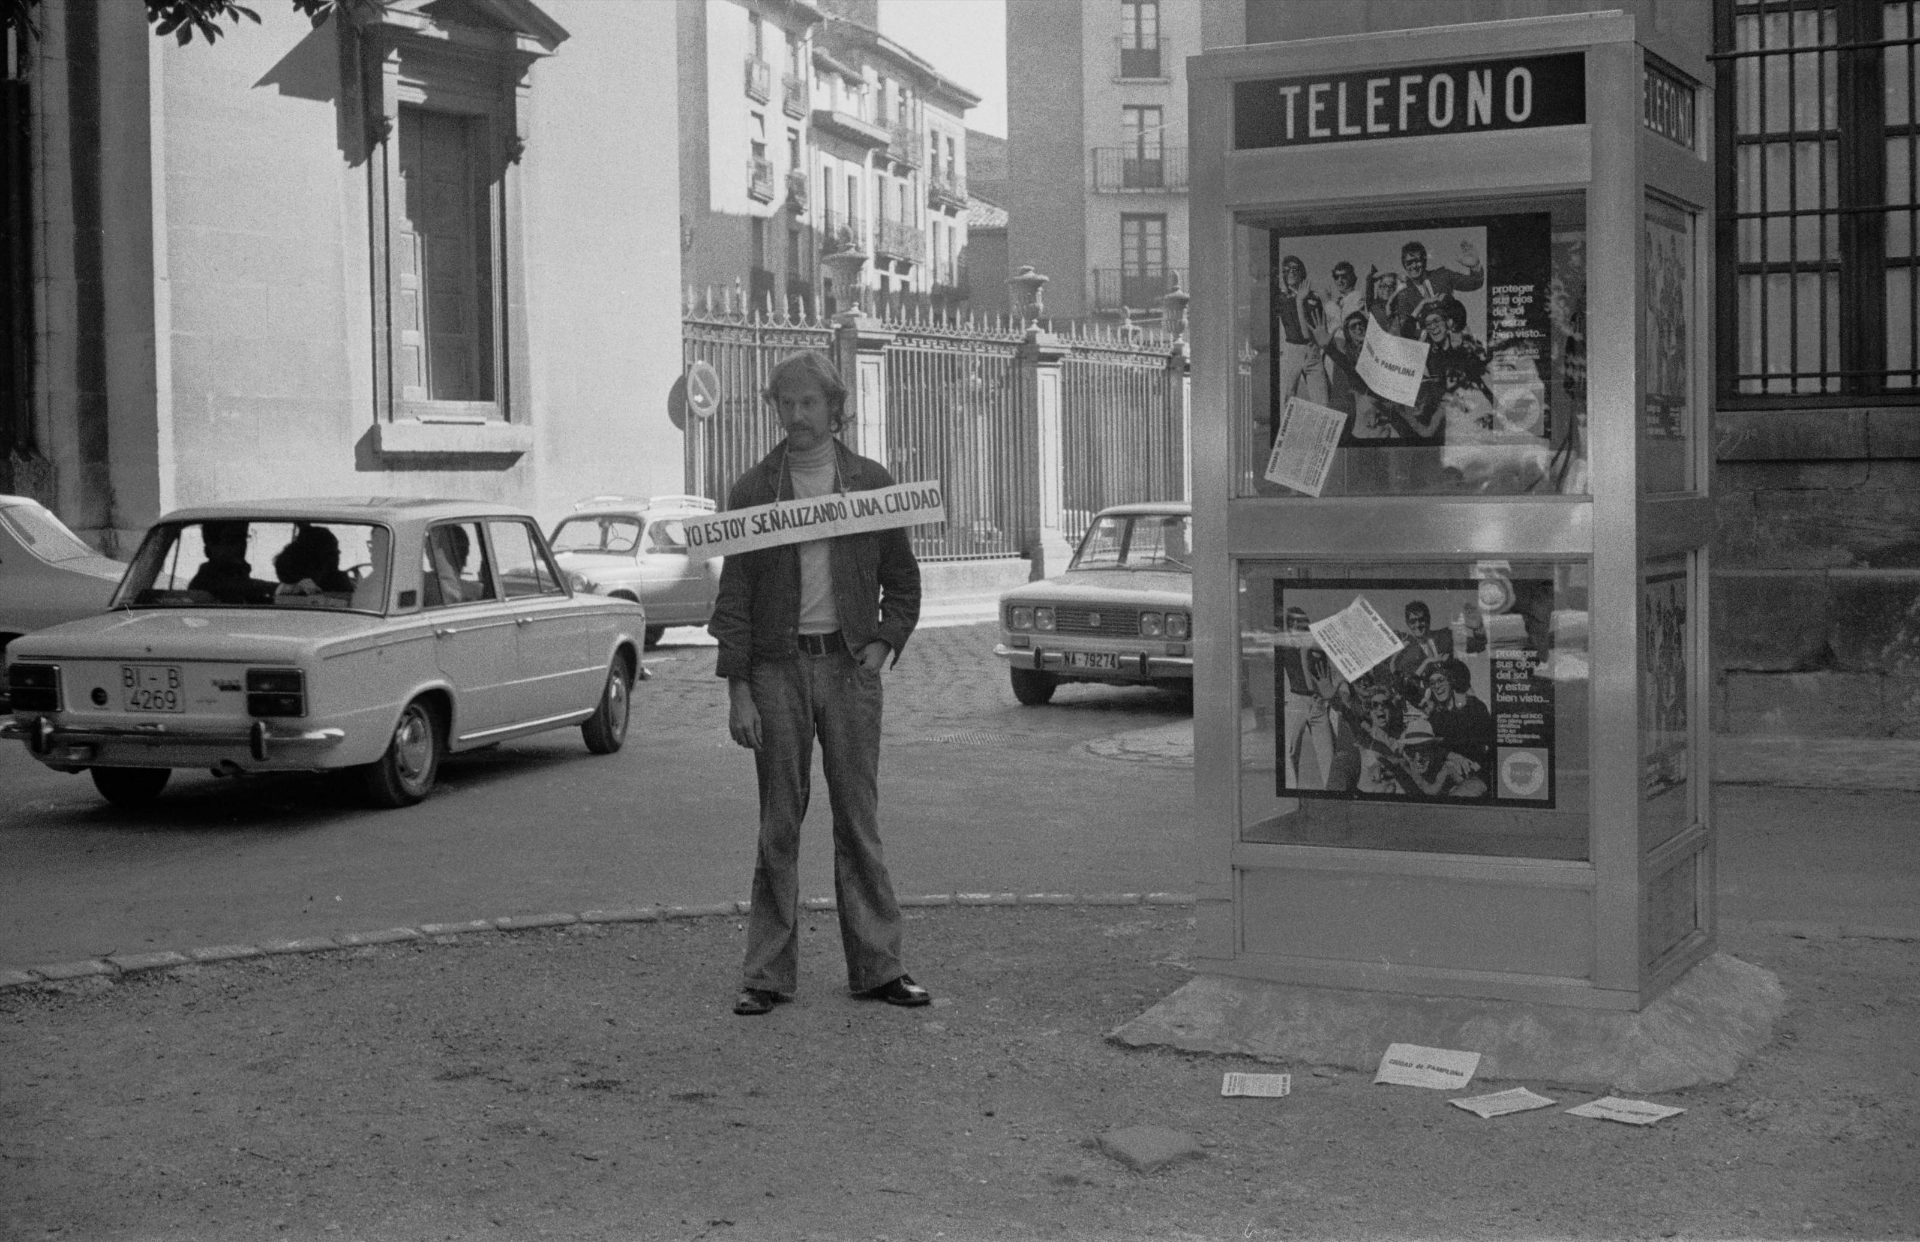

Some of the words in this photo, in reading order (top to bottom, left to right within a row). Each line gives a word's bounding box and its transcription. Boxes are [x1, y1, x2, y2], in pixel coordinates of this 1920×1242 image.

[1279, 66, 1533, 140] TELEFONO
[1492, 285, 1535, 296] proteger
[1492, 295, 1509, 305] sus
[1512, 295, 1533, 306] ojos
[1510, 305, 1524, 316] sol
[1493, 321, 1500, 330] y
[1380, 360, 1416, 378] PAMPLONA
[683, 525, 703, 548] YO
[704, 516, 747, 544] ESTOY
[751, 501, 848, 535] SEÑALIZANDO
[849, 497, 884, 518] UNA
[884, 488, 941, 514] CIUDAD
[1495, 649, 1538, 661] proteger
[1496, 660, 1513, 669] sus
[1515, 659, 1537, 671] ojos
[1496, 670, 1511, 680] del
[1513, 670, 1528, 680] sol
[1496, 683, 1504, 693] y
[1505, 682, 1531, 691] estar
[130, 690, 177, 710] 4269
[1496, 692, 1518, 702] bien
[1388, 1058, 1413, 1068] CIUDAD
[1426, 1064, 1464, 1077] PAMPLONA
